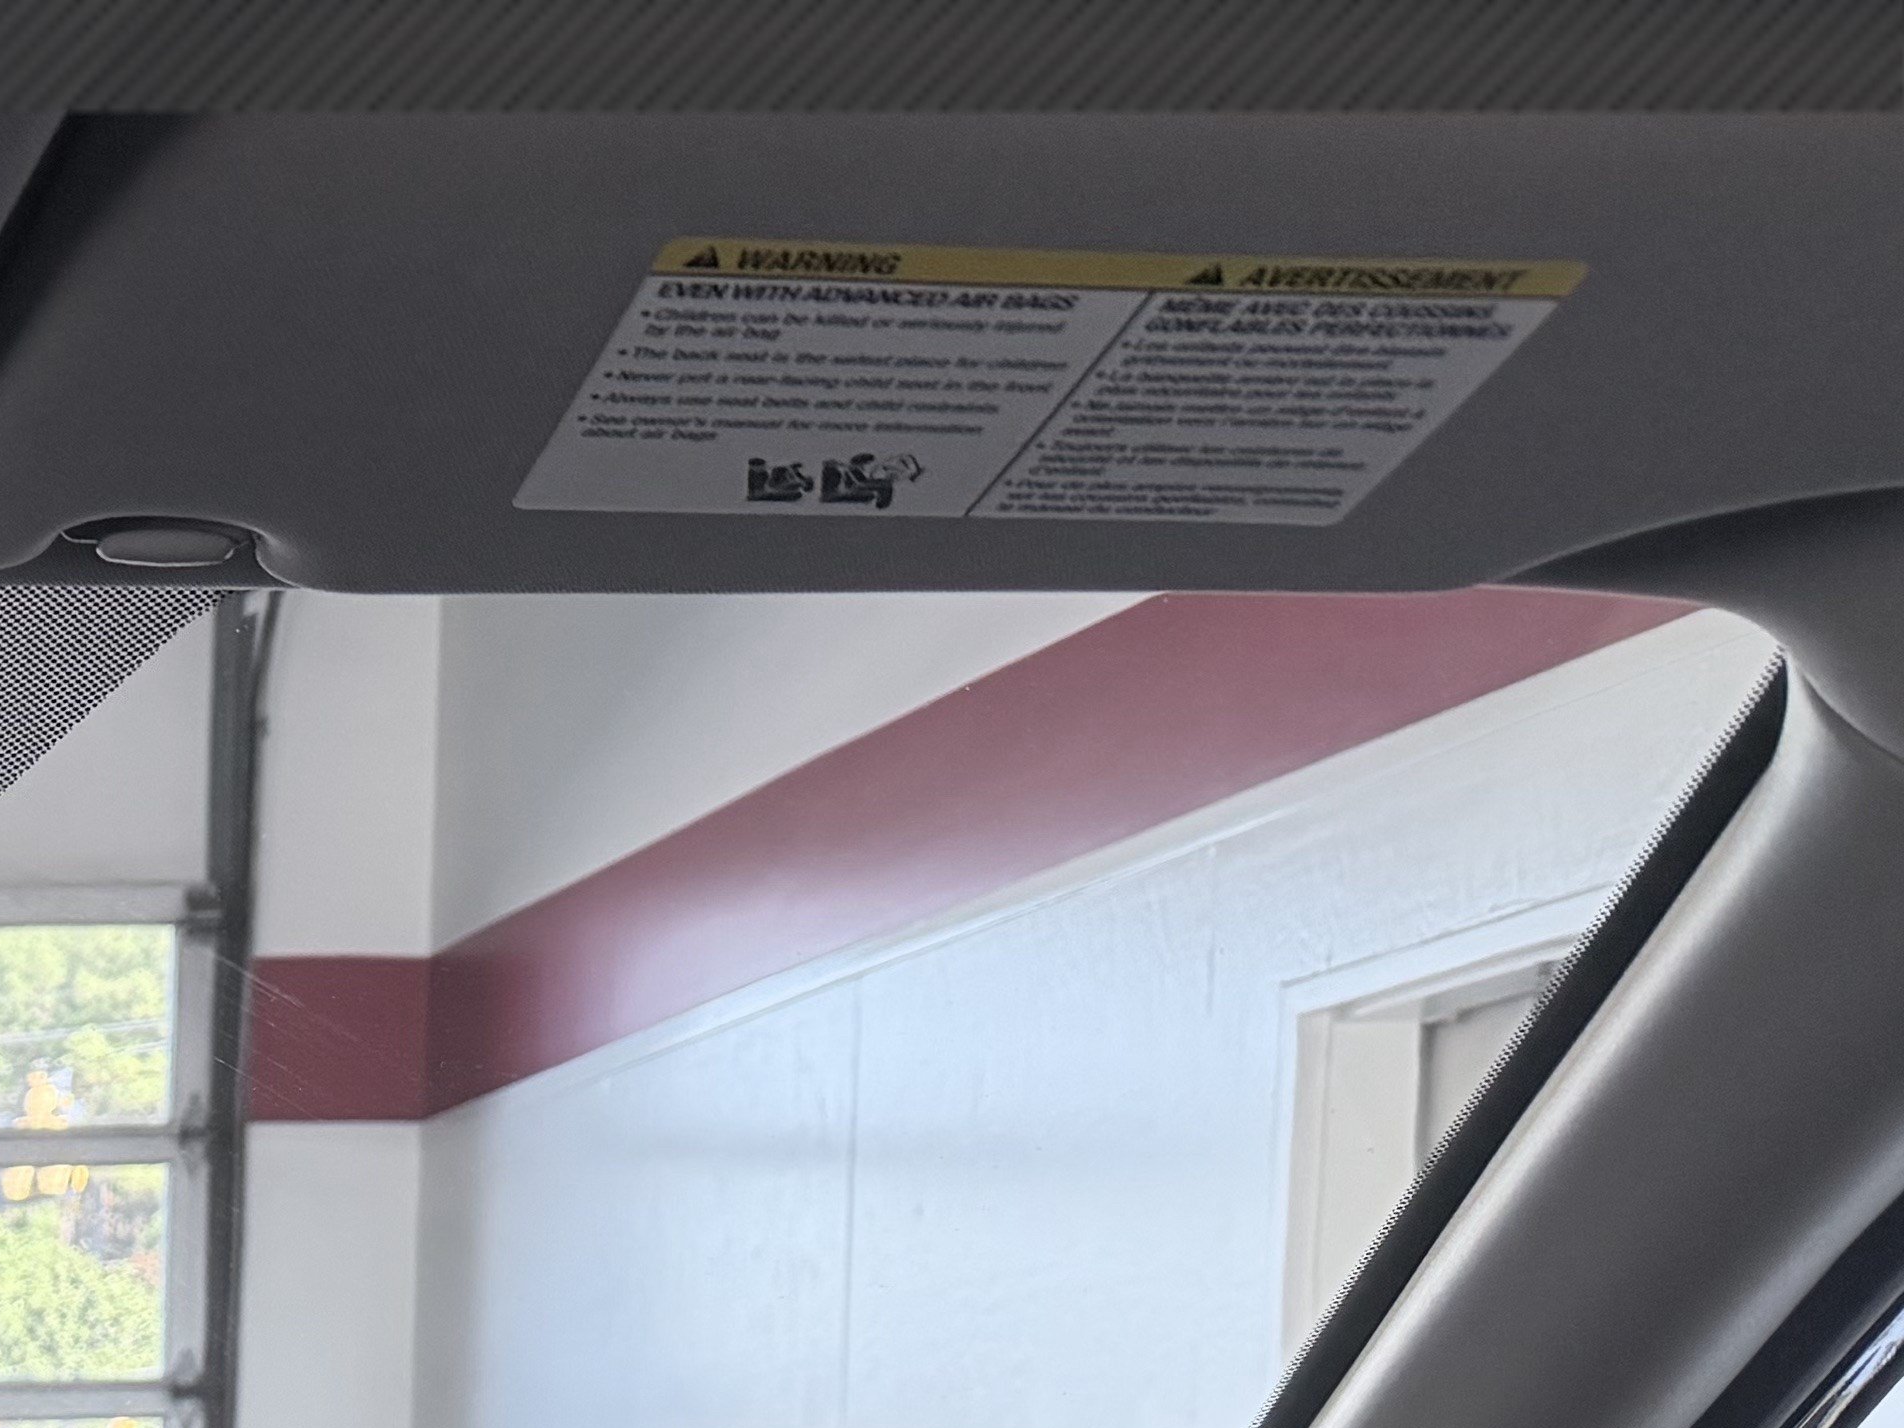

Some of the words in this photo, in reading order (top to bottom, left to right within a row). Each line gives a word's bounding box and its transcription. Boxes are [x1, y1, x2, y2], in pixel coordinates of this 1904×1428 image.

[737, 248, 901, 275] WARNING
[657, 281, 729, 299] EVEN
[1239, 264, 1527, 290] AVERTISSEMENT
